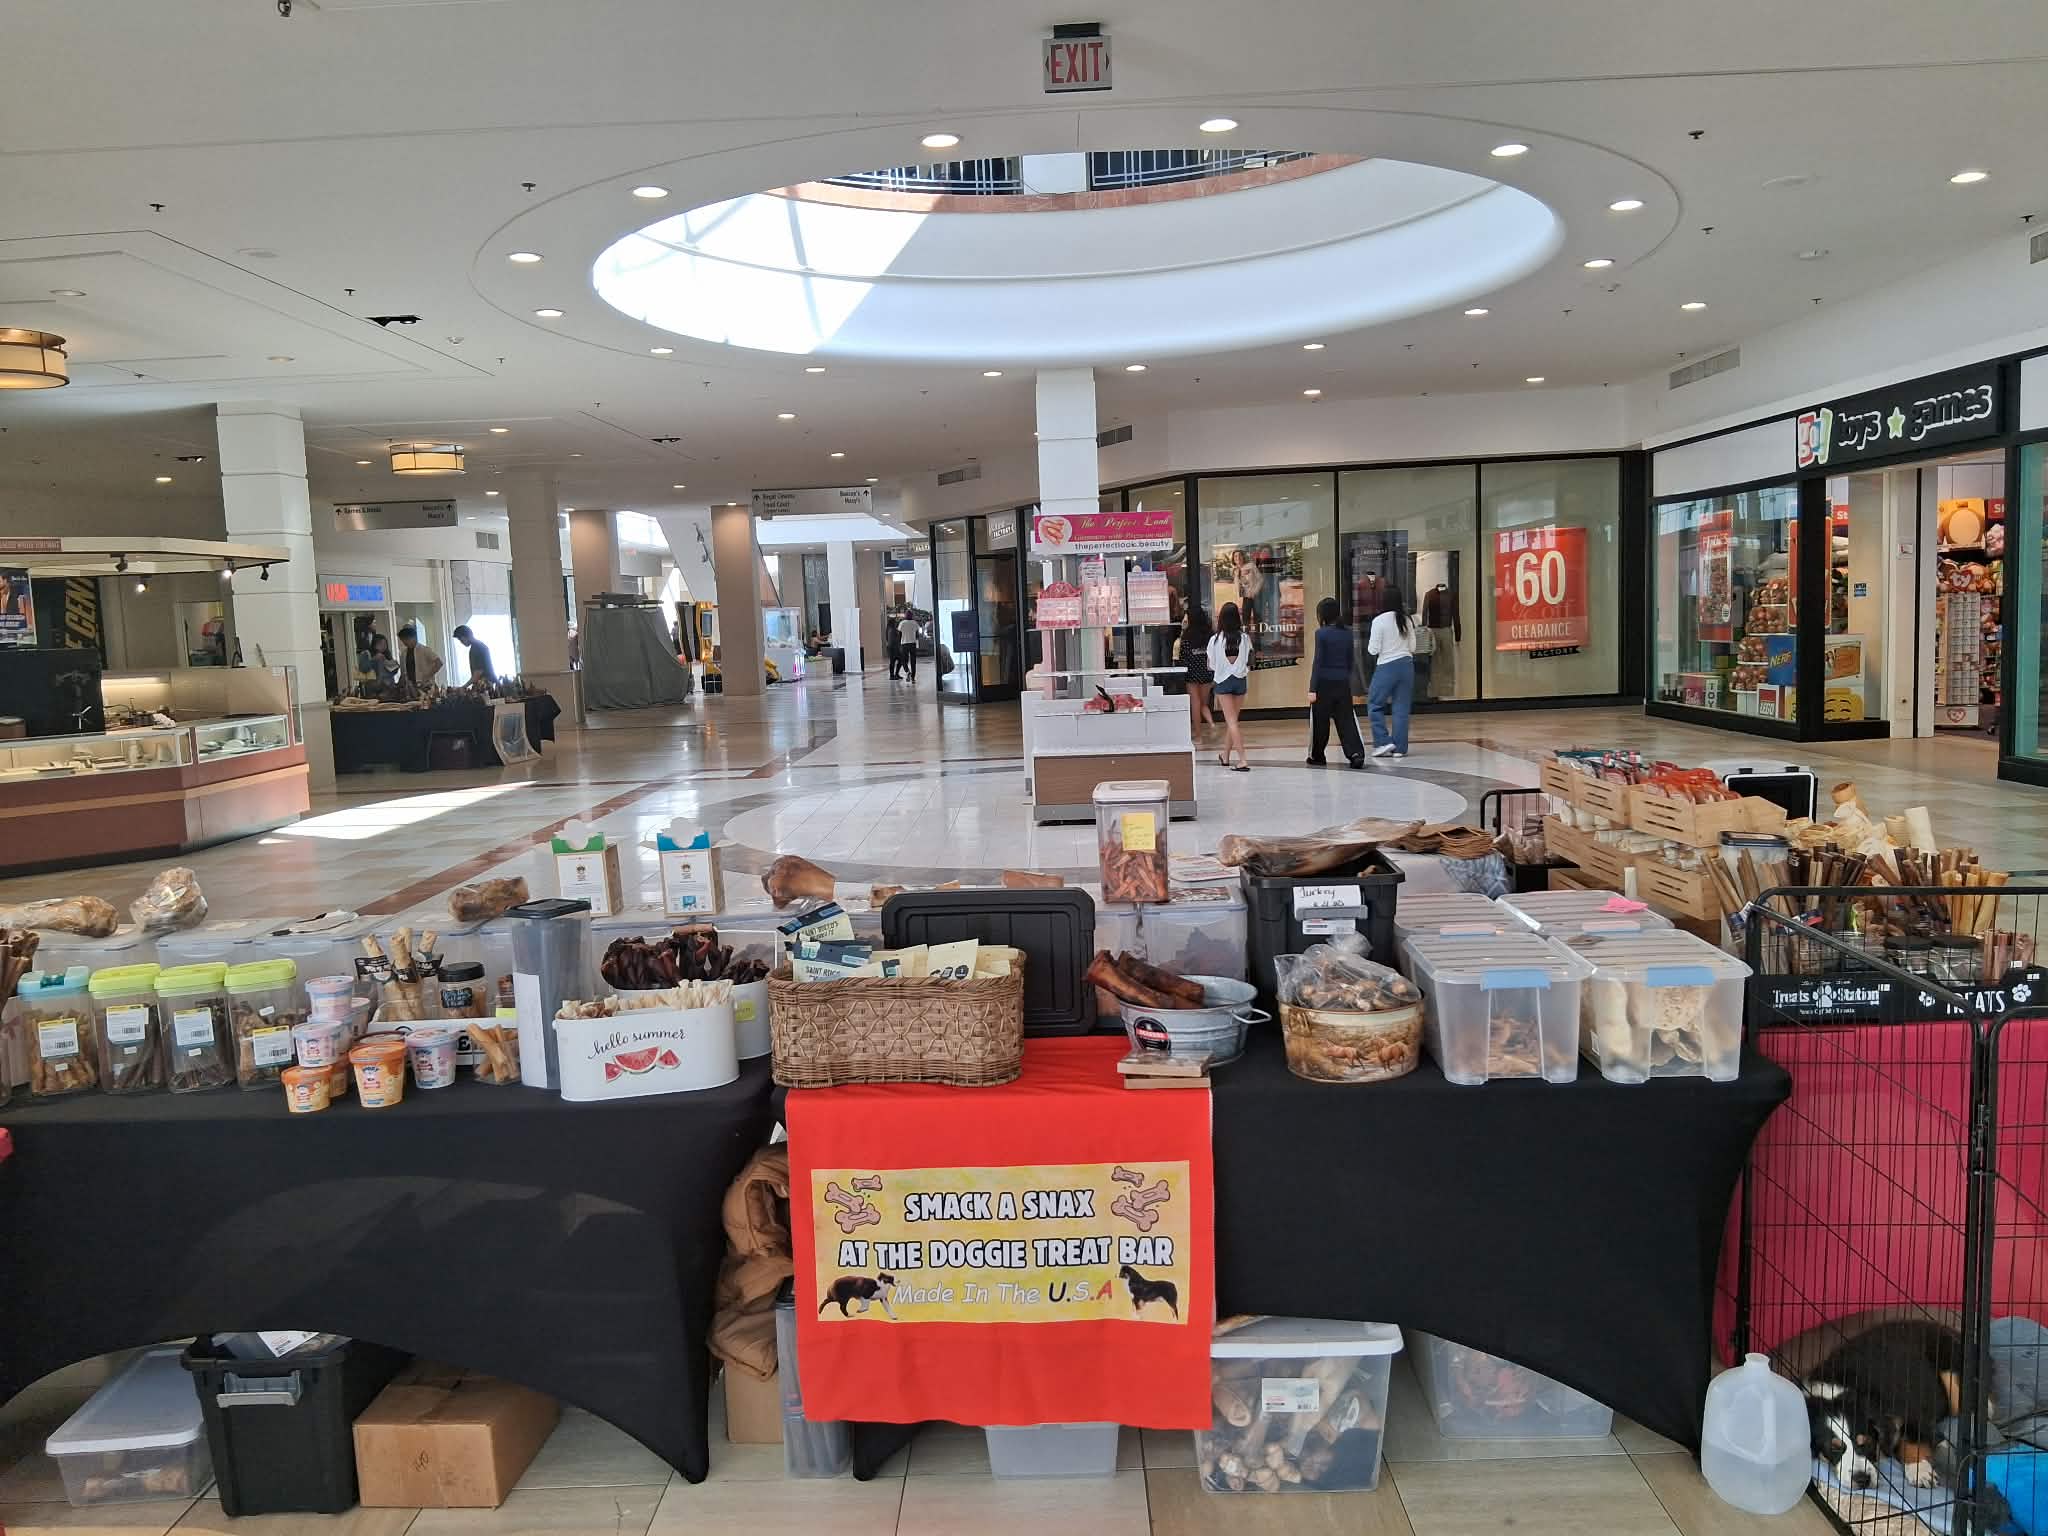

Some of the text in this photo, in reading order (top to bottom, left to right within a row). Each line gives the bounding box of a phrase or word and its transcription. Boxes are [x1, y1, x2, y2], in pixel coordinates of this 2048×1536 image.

[1050, 42, 1103, 83] EXIT
[1838, 384, 1993, 450] toys games
[1080, 517, 1096, 529] The
[1103, 517, 1137, 530] Perfect
[1516, 550, 1566, 607] 60
[1259, 622, 1297, 633] Denim
[1511, 621, 1572, 640] CLEARANCE
[1770, 652, 1793, 667] NERF
[1760, 702, 1775, 714] LEGO
[805, 965, 822, 975] SAINT
[1772, 987, 1880, 1004] Treats Station
[588, 1028, 688, 1060] hello summer
[905, 1189, 1095, 1222] SMACK A SNAX
[838, 1236, 1175, 1269] AT THE DOGGIE TREAT BAR
[891, 1280, 1113, 1304] Made In The U.S.A
